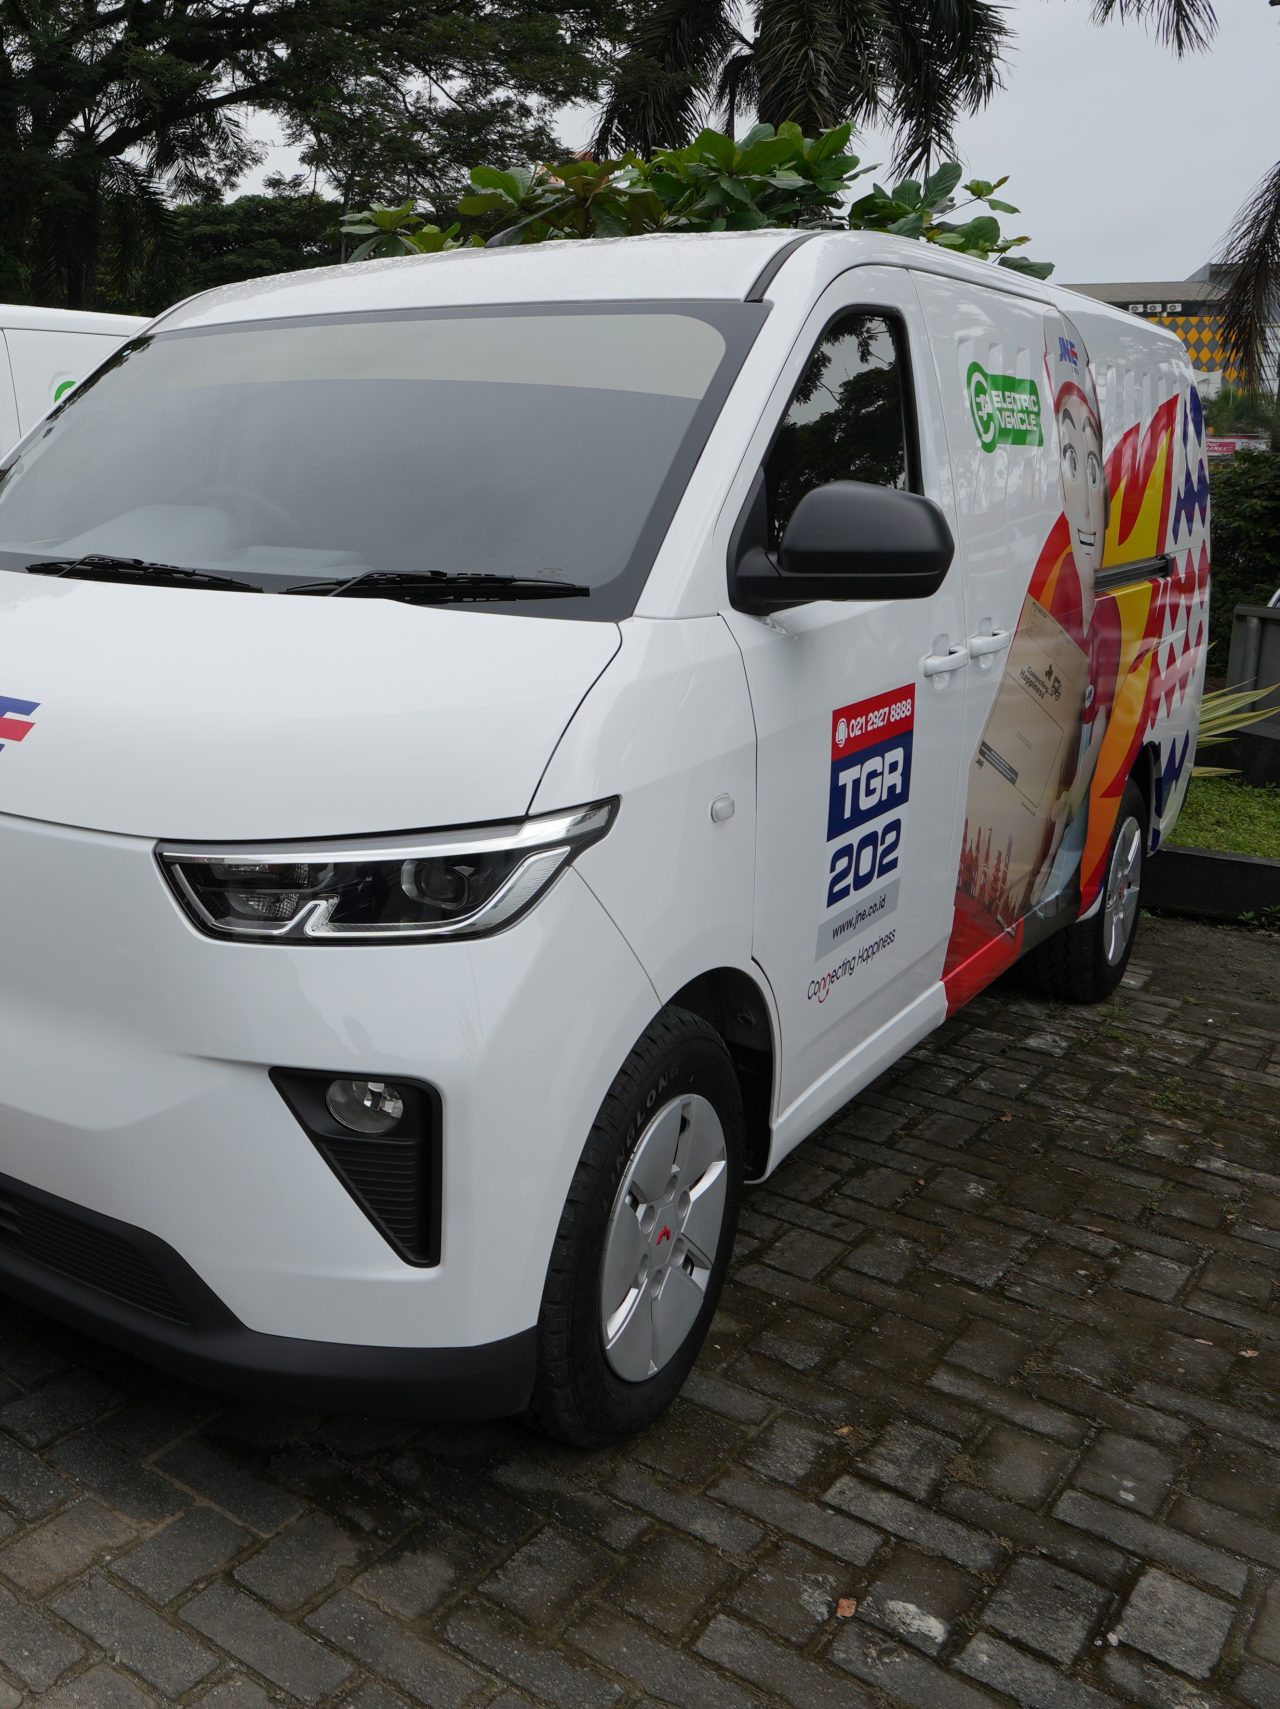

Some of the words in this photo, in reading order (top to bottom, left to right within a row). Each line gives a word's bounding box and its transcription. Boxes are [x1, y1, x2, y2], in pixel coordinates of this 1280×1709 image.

[990, 390, 1038, 412] ELECTRIC
[996, 410, 1037, 431] VEHICLE
[1020, 668, 1045, 699] Happiness
[848, 715, 866, 738] 021
[867, 706, 890, 731] 2927
[890, 698, 912, 722] 8888
[838, 746, 905, 820] TGR
[826, 817, 902, 909] 202
[832, 893, 887, 940] www.jne.co.id
[807, 957, 856, 1003] Connecting
[856, 929, 896, 968] Happiness
